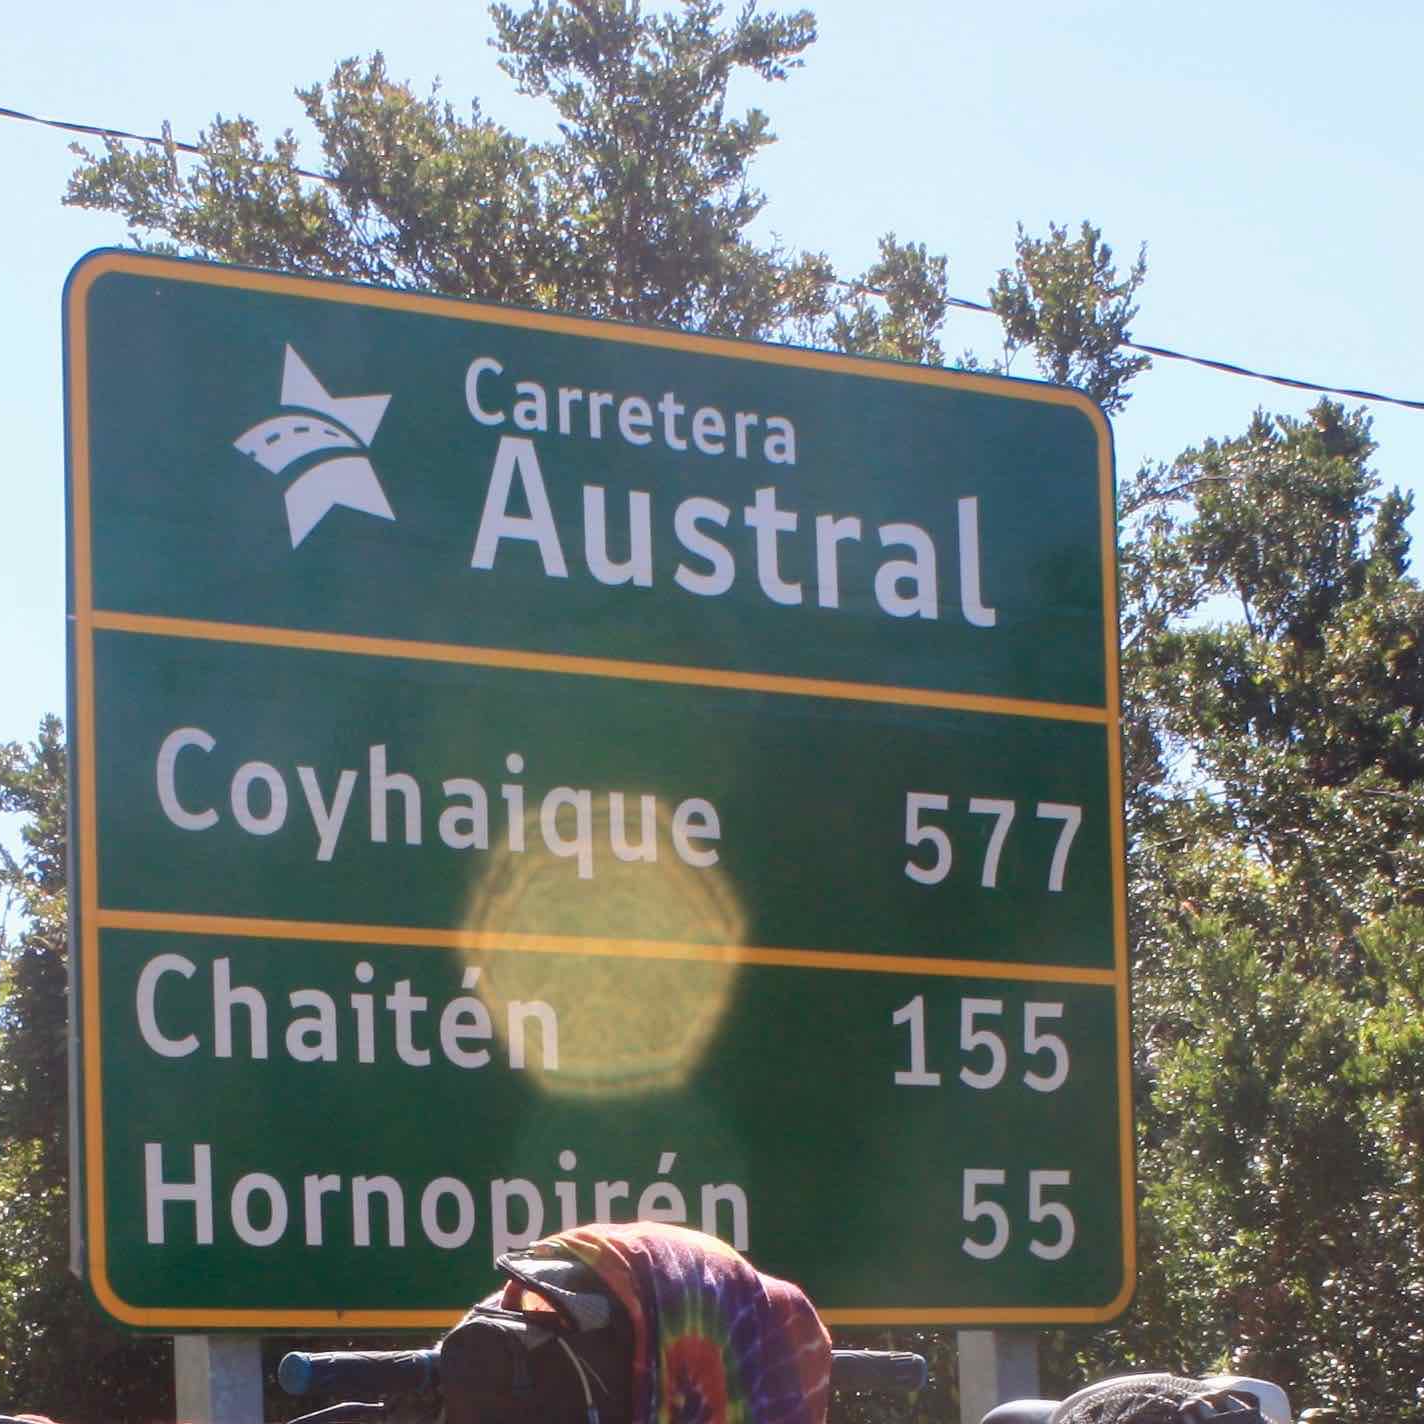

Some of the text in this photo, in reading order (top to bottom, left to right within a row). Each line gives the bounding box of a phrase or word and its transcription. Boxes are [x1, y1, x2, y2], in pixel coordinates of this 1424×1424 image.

[464, 357, 798, 465] Carretera
[471, 435, 997, 627] Austral
[156, 727, 1083, 892] Coyhaique 577
[136, 953, 1070, 1093] Chaitén 155
[144, 1142, 1076, 1269] Hornopirén 55
